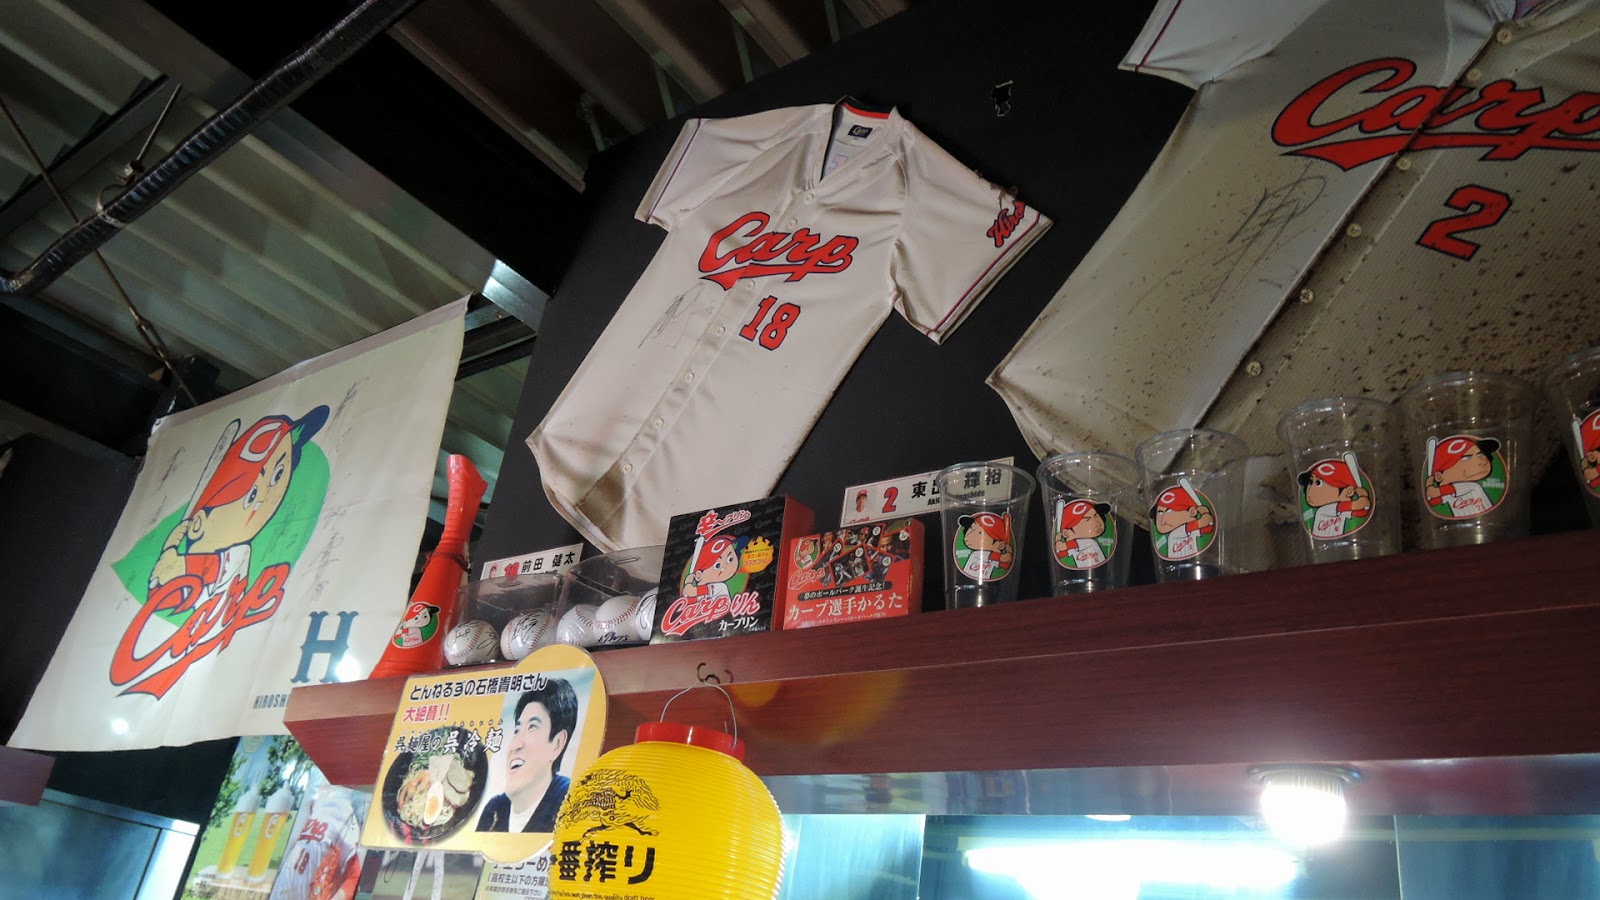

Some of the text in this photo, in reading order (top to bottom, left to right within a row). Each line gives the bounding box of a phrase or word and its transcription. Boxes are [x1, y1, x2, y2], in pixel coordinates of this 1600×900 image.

[1271, 57, 1600, 171] Carp
[1415, 184, 1512, 261] 2
[698, 211, 859, 291] Carp
[739, 295, 800, 351] 18
[881, 486, 899, 513] 2
[521, 557, 544, 573] 前田
[551, 551, 576, 568] 健太
[788, 592, 903, 621] カープ選手かるた
[109, 562, 291, 701] Carp
[718, 616, 760, 632] カープリン
[290, 610, 359, 684] H
[253, 693, 289, 709] HIROSH
[409, 673, 548, 701] とんねるずの石橋貴明さん
[403, 703, 451, 722] 大絶賛!!
